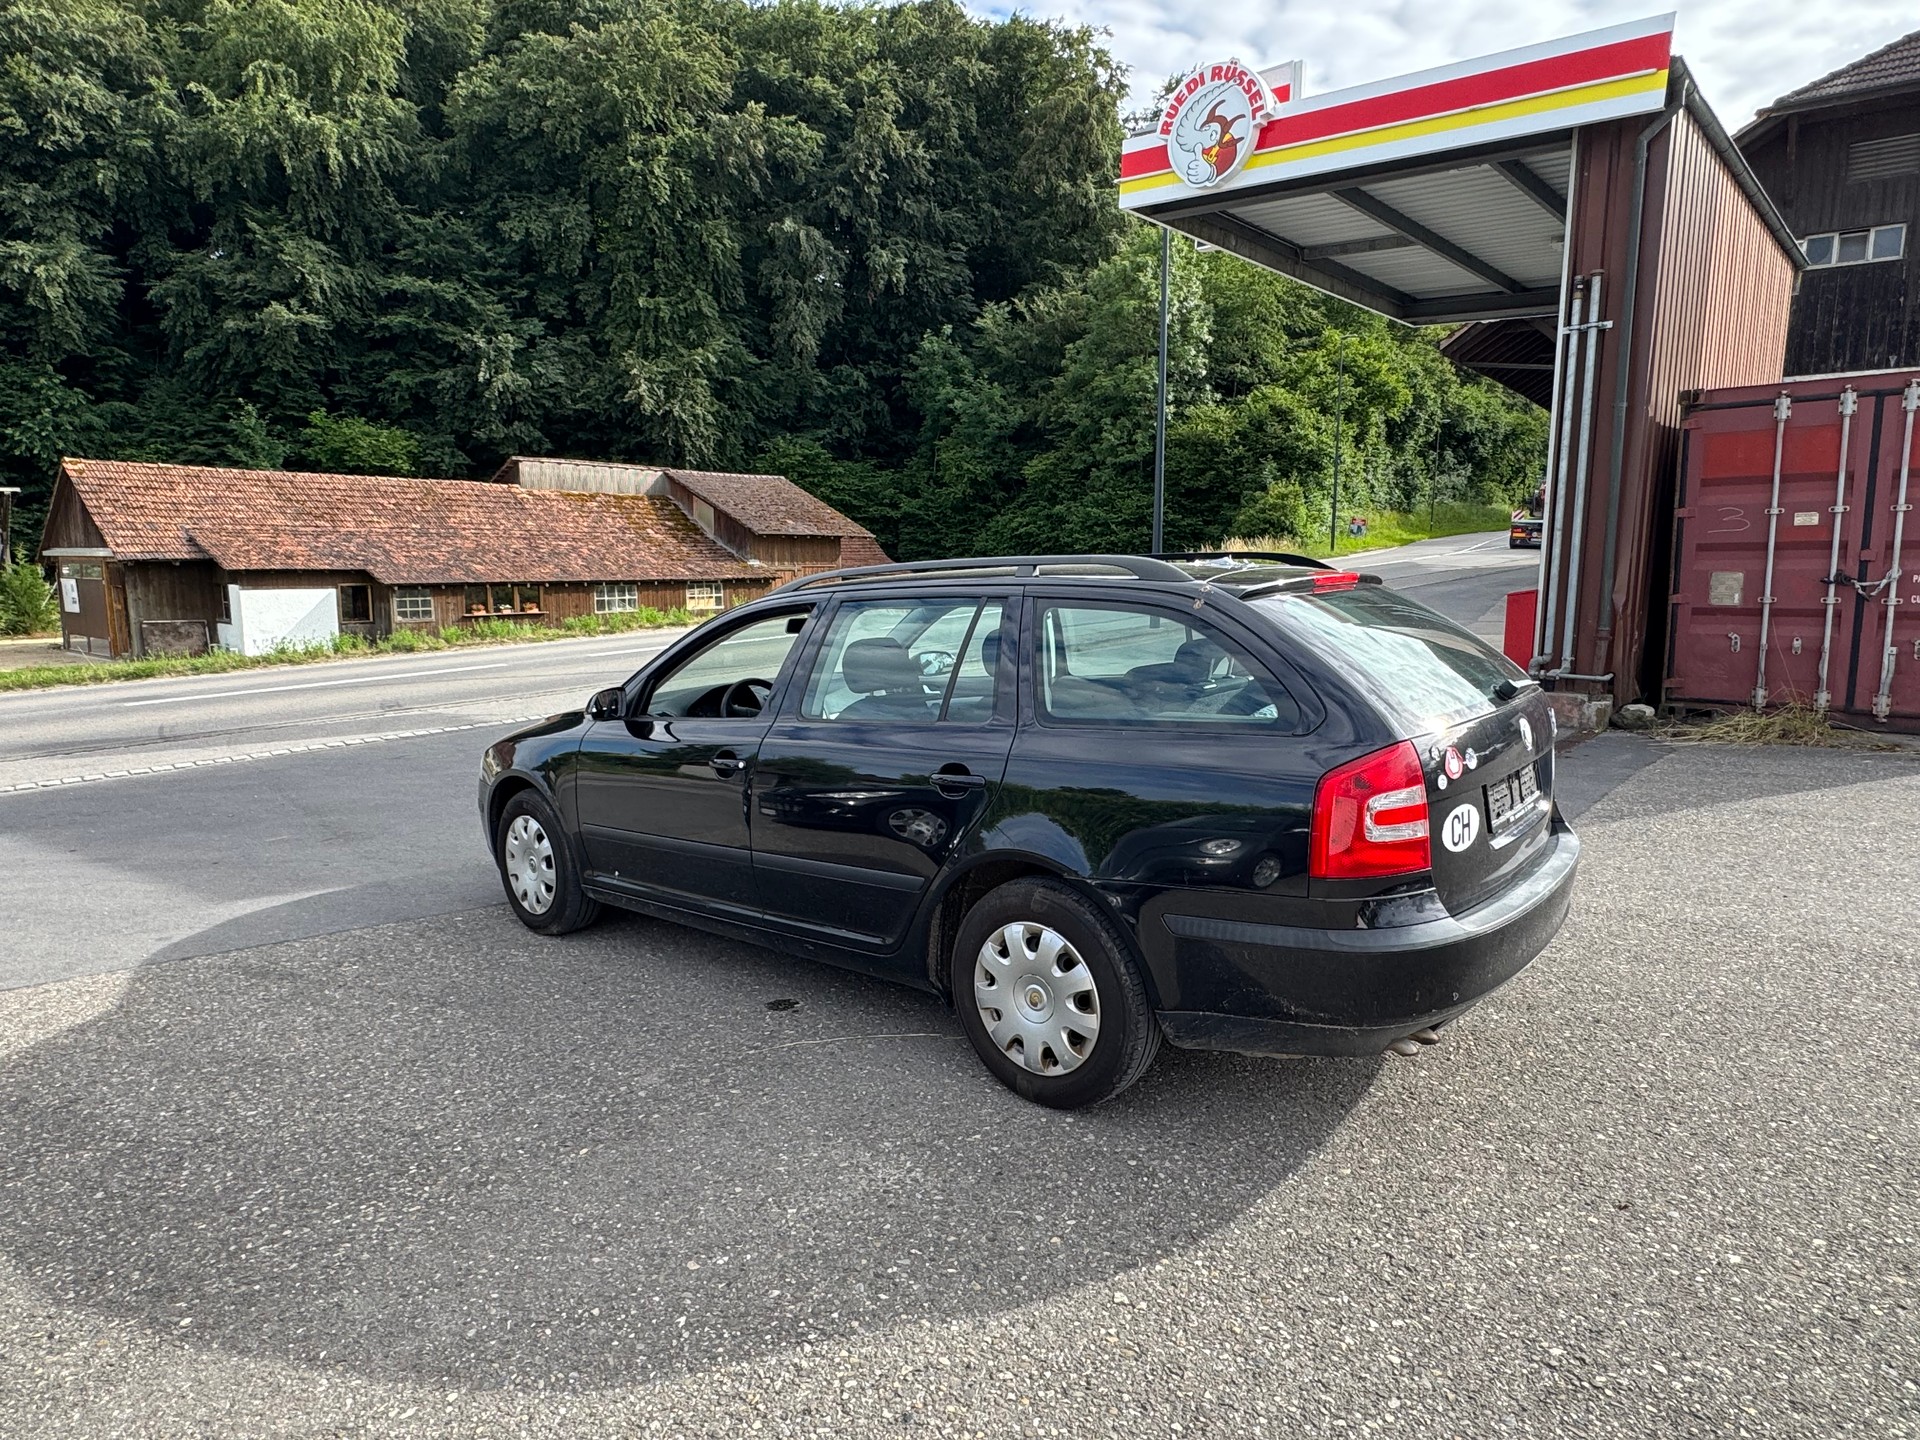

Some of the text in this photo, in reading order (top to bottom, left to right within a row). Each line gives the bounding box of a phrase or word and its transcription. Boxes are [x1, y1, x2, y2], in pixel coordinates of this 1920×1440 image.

[1160, 60, 1265, 135] RUEDI RÜSSEL
[1707, 506, 1750, 533] 3
[1451, 809, 1471, 847] CH
